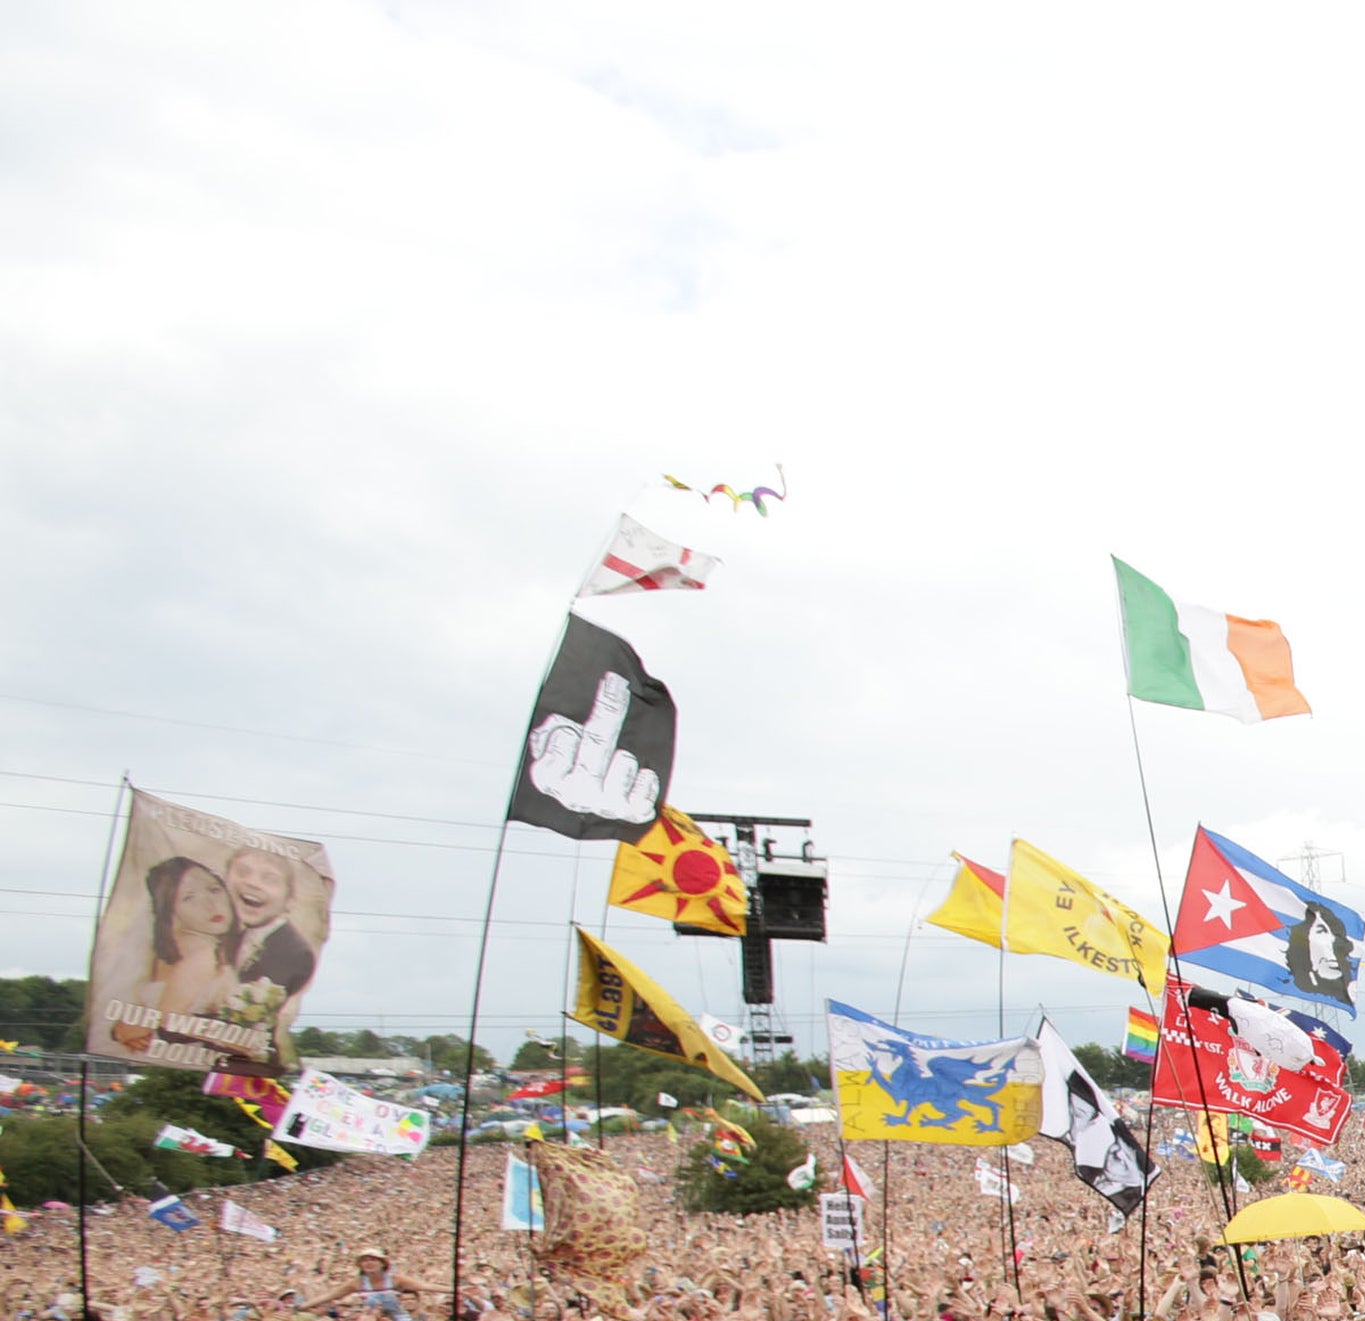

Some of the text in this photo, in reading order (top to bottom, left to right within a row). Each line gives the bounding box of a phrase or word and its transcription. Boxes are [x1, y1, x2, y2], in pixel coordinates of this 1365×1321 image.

[105, 999, 163, 1031] OUR
[1214, 1071, 1293, 1114] WALK ALONE
